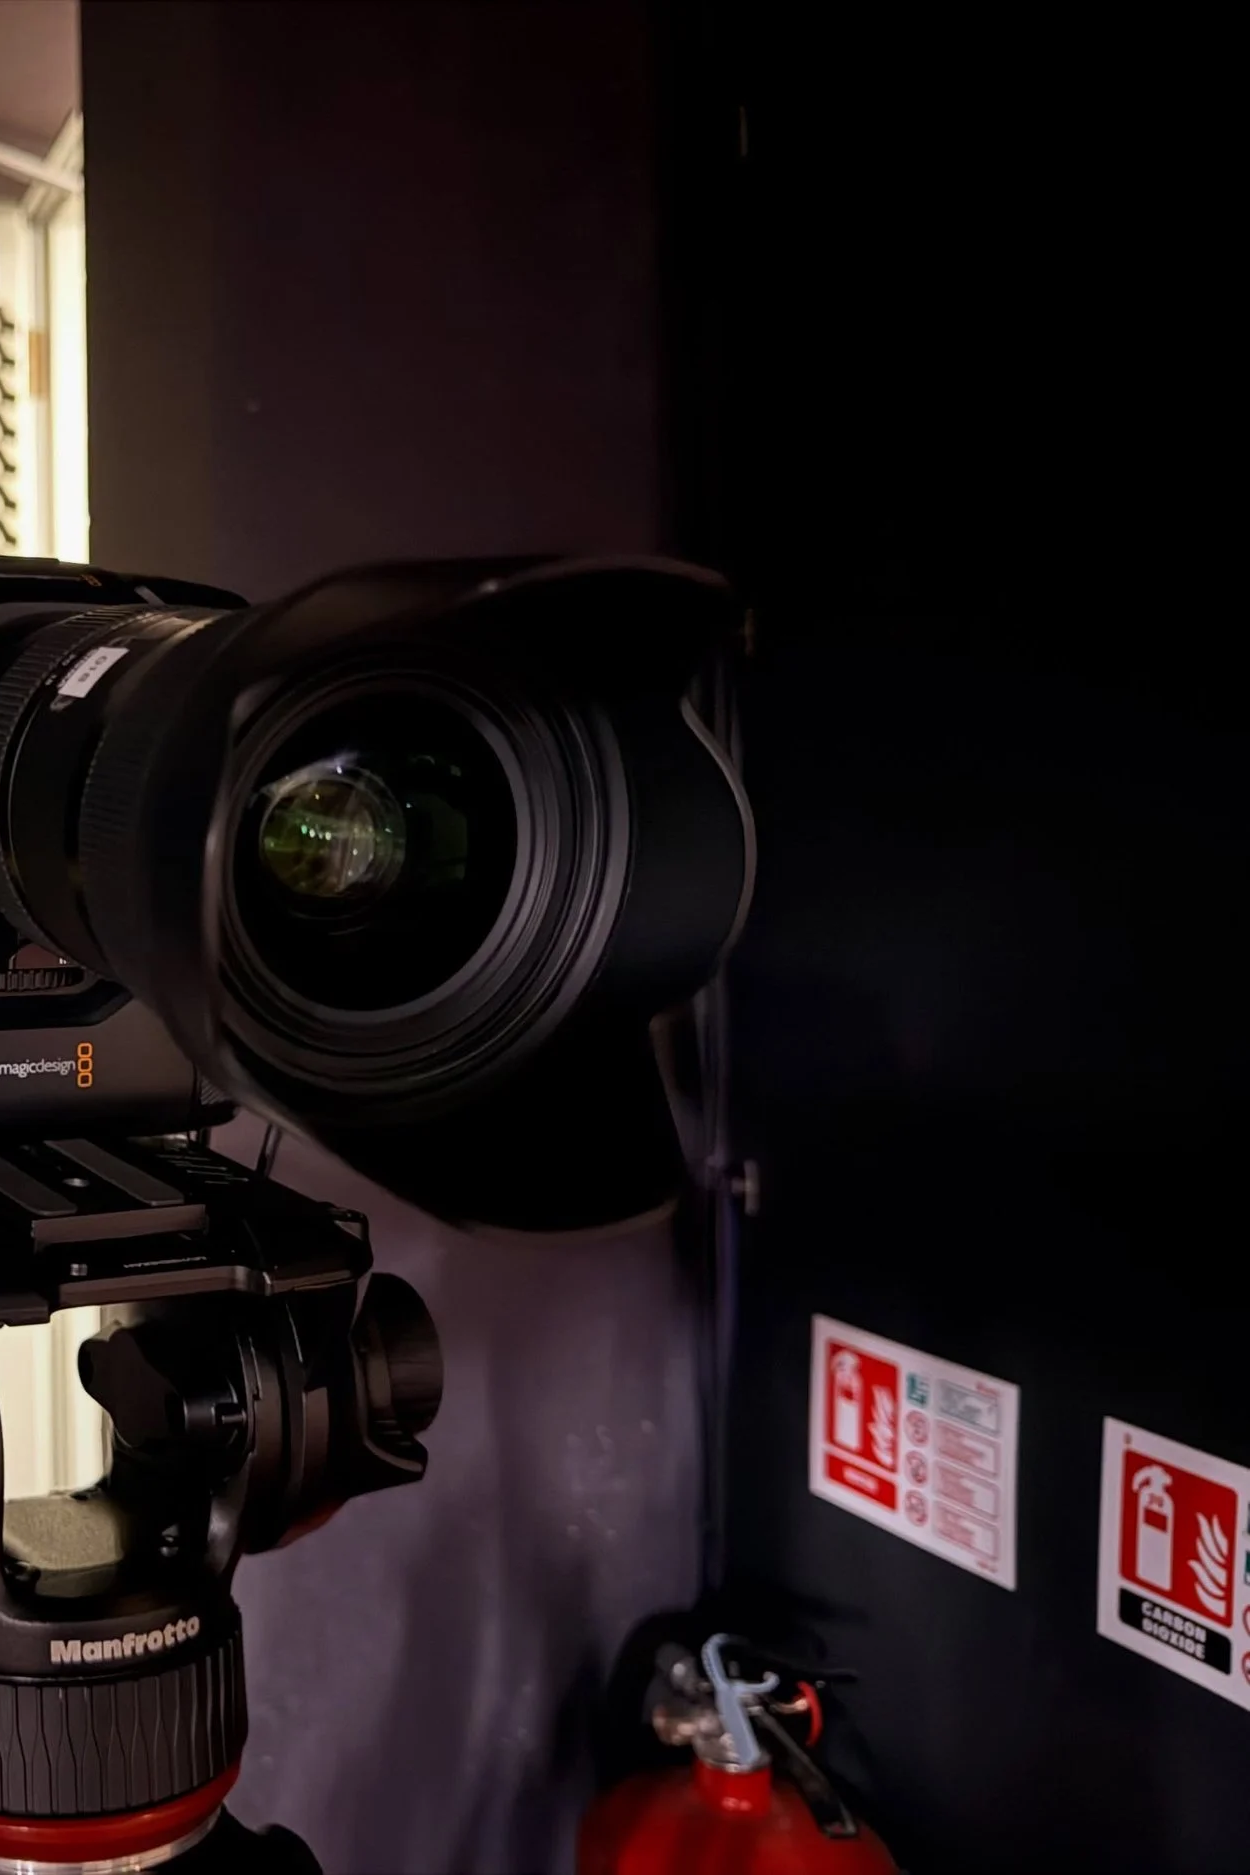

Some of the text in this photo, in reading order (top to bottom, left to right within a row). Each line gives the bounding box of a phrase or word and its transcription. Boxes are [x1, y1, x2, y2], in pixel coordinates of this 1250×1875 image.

[50, 1615, 201, 1665] Manfrotto
[1141, 1600, 1207, 1643] CARBON
[1141, 1618, 1206, 1661] DIOXIDE
